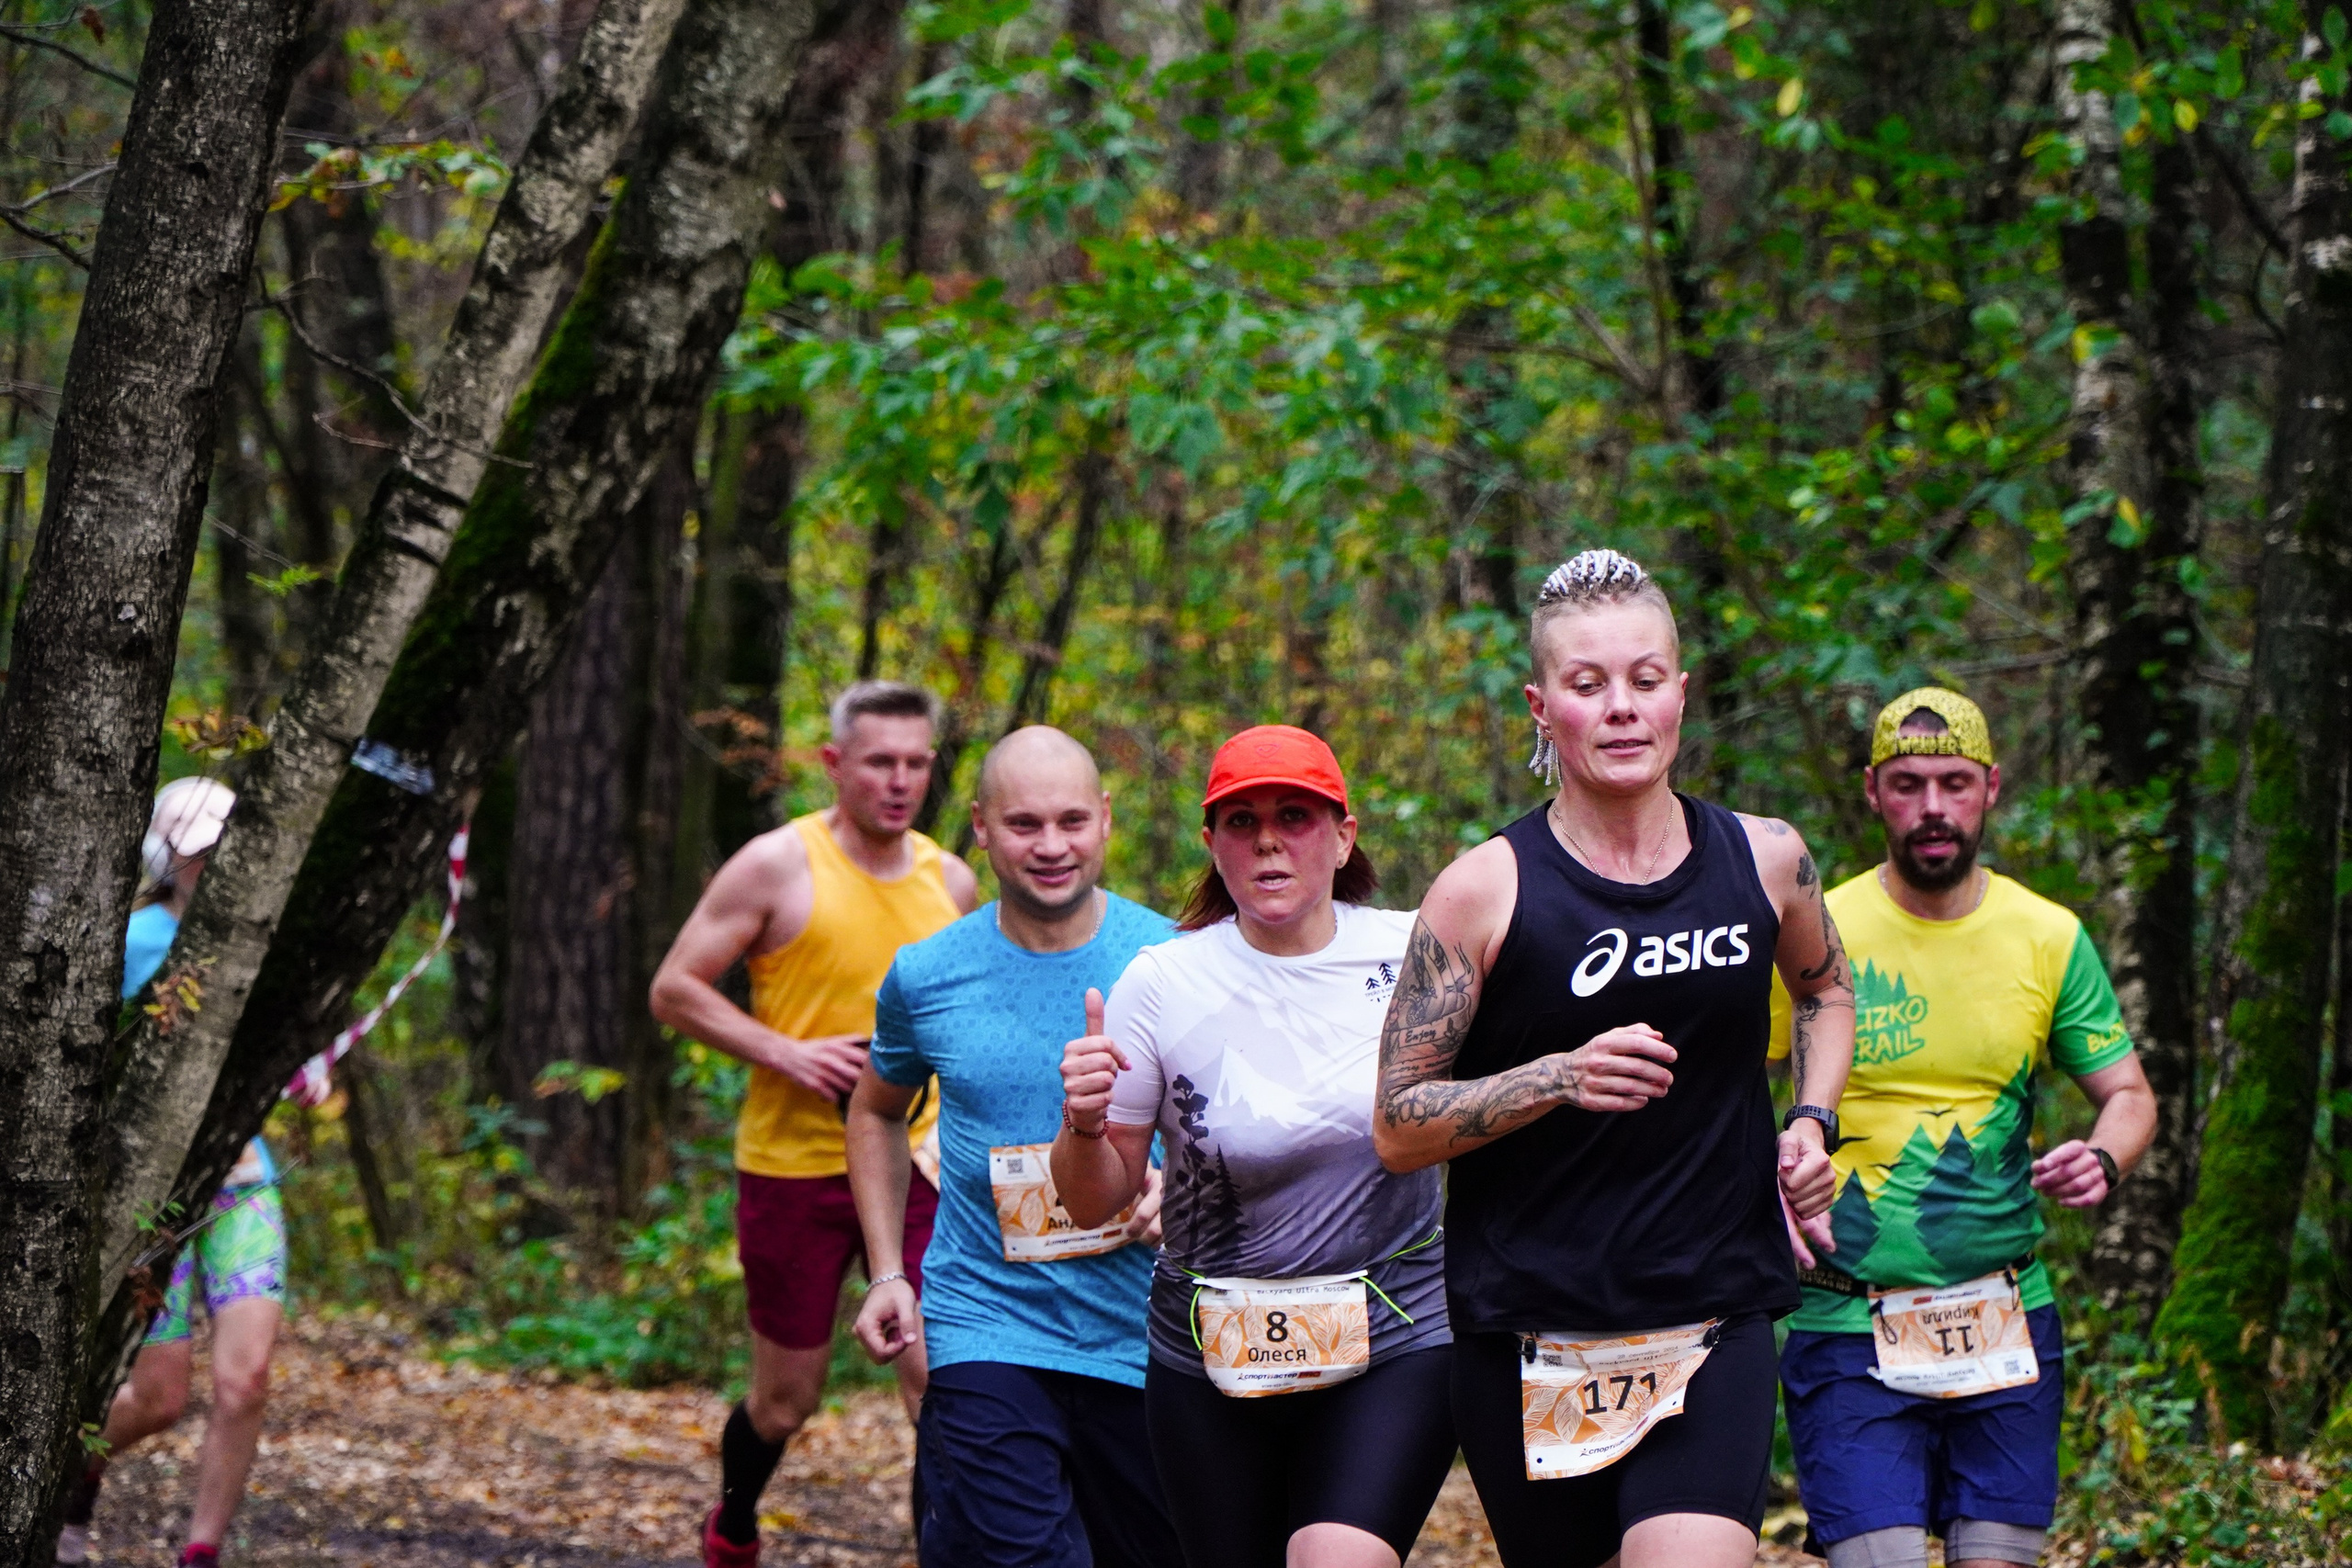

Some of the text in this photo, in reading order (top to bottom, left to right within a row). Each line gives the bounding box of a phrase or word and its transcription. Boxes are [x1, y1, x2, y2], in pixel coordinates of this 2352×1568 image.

[1855, 998, 1925, 1032] IZKO
[1855, 1030, 1921, 1061] RAIL
[1266, 1311, 1288, 1342] 8
[1935, 1325, 1974, 1356] 11
[1248, 1347, 1306, 1362] Олеся
[1583, 1371, 1657, 1415] 171
